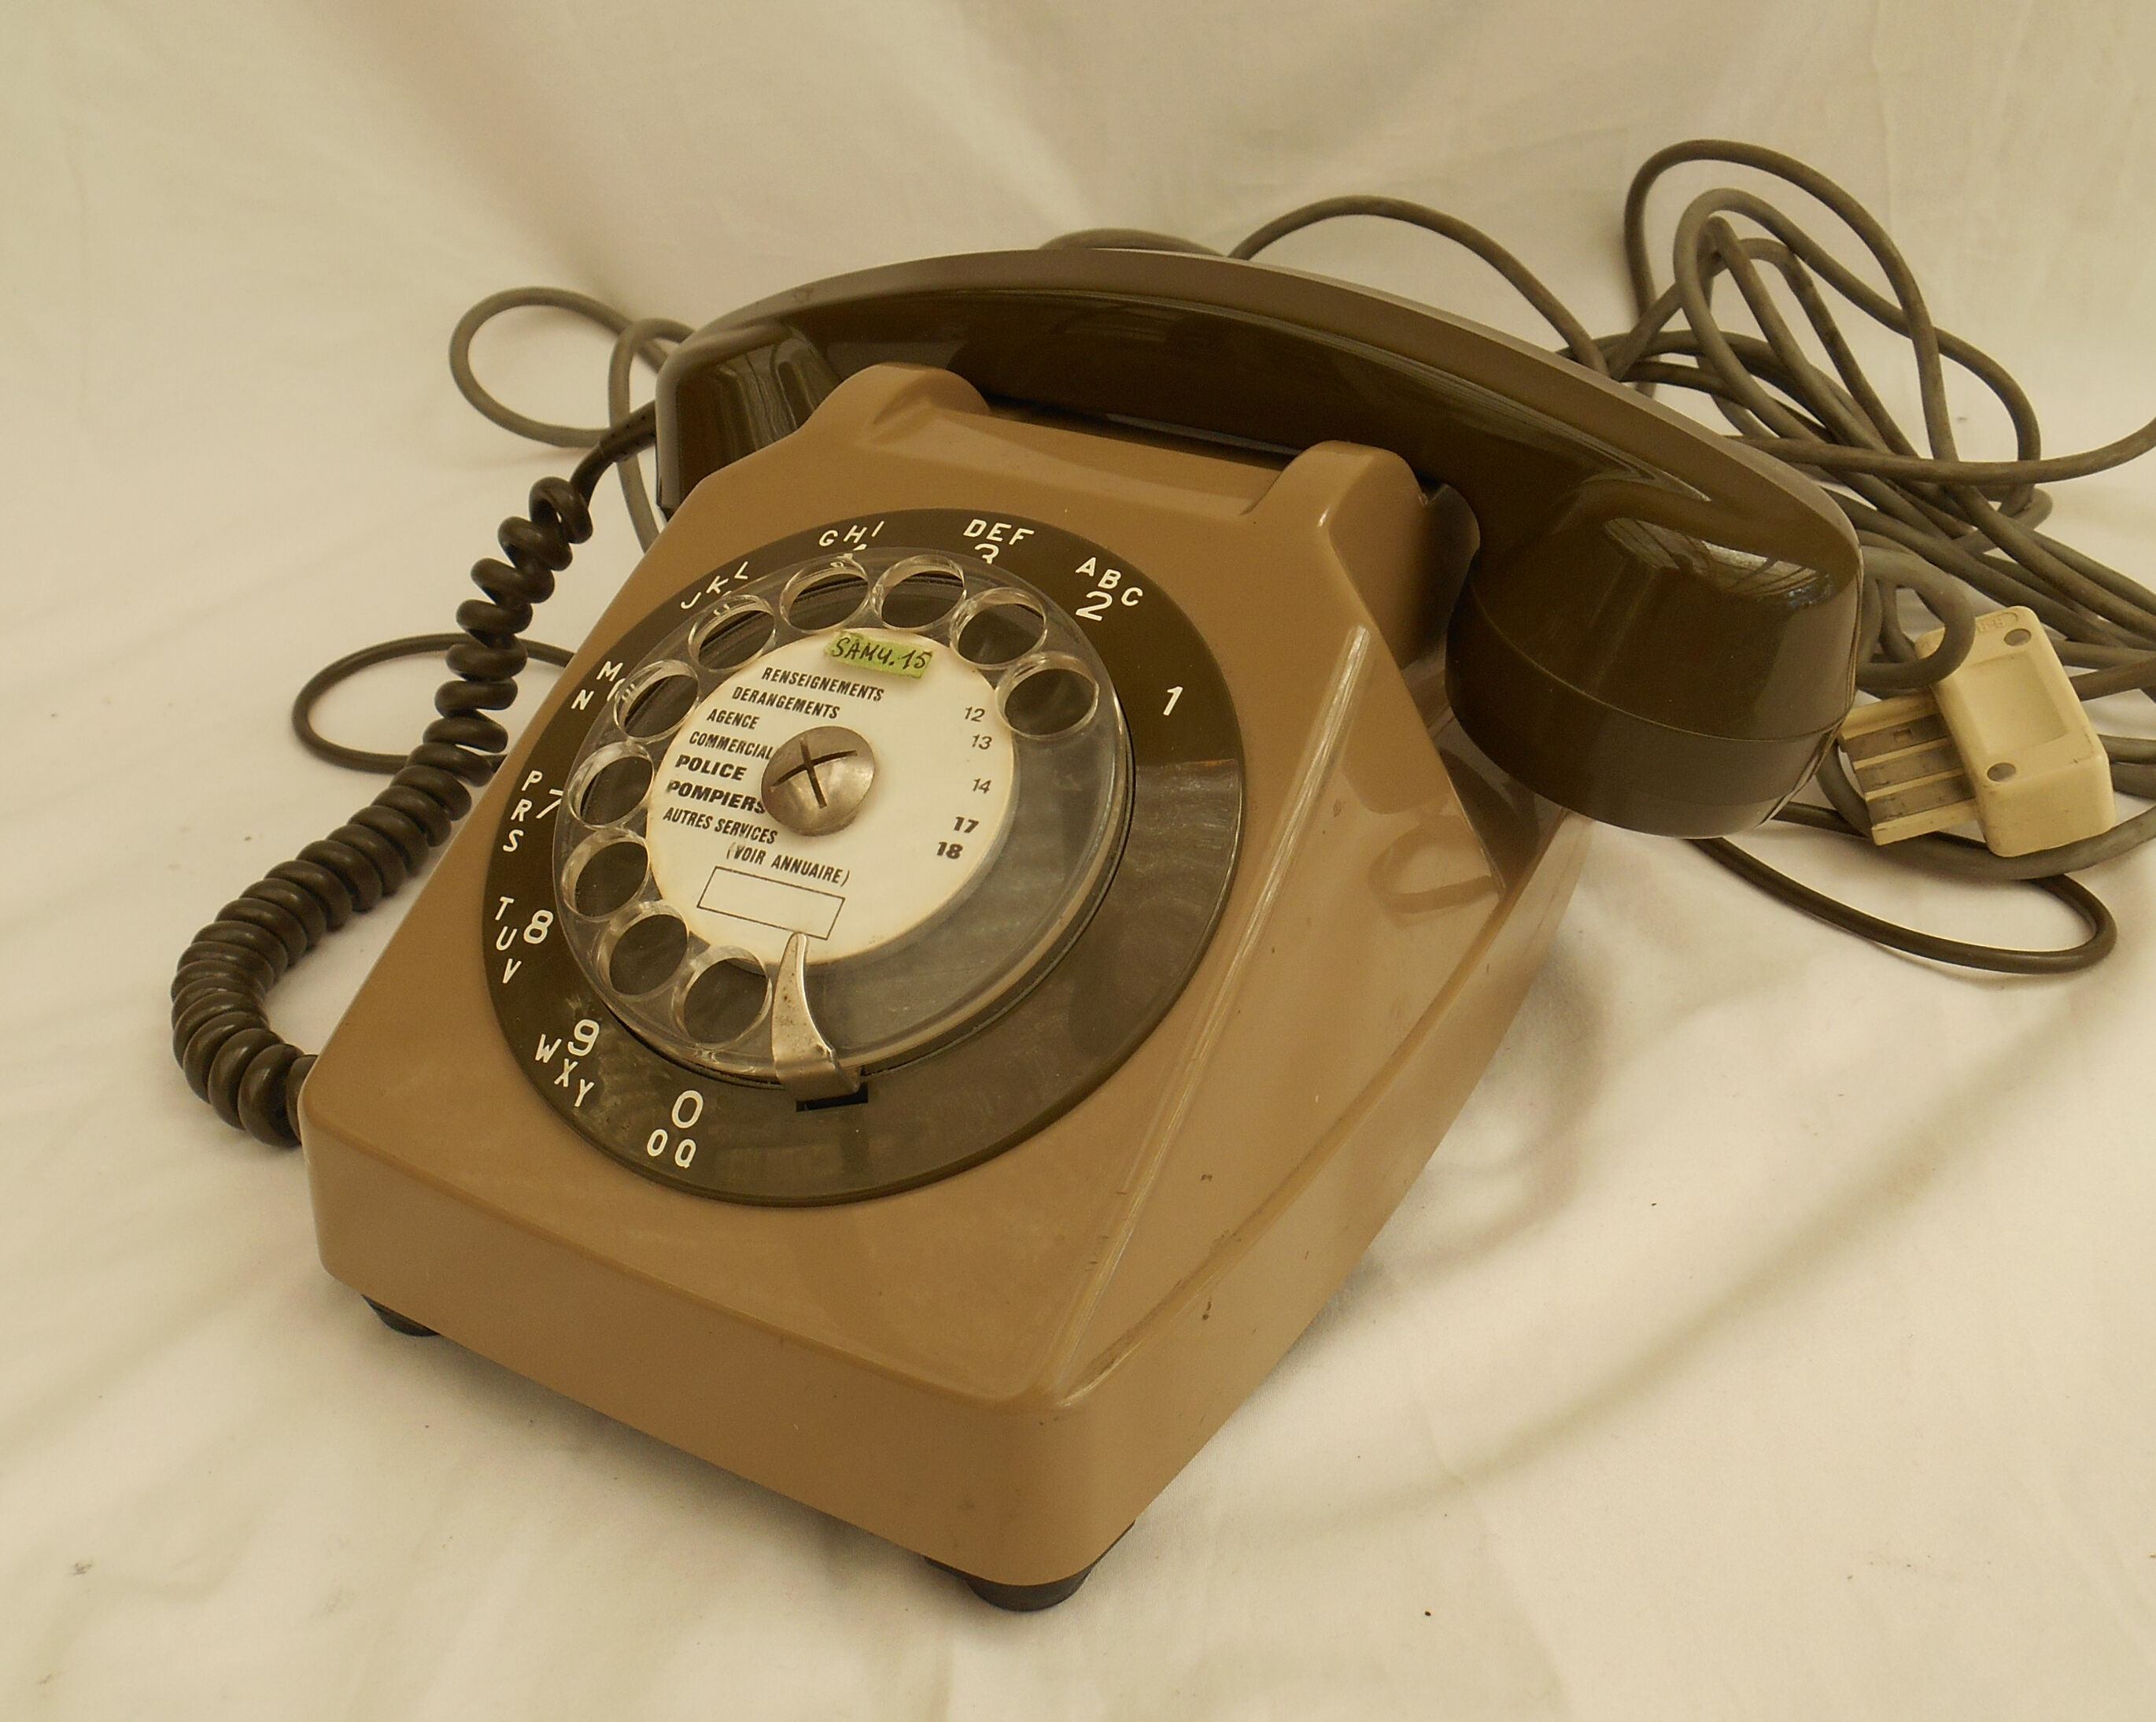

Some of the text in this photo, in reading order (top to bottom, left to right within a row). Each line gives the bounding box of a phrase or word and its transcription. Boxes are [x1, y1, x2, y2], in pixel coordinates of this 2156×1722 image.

[819, 520, 884, 547] GHI
[962, 519, 1035, 545] DEF
[681, 561, 748, 609] JKL
[1075, 556, 1143, 606] ABC
[1075, 590, 1113, 622] 2
[762, 667, 985, 722] RENSEIGNEMENTS 12
[1161, 685, 1183, 715] 1
[707, 708, 760, 730] AGENCE
[732, 686, 992, 750] DERANGEMENTS 13
[536, 789, 563, 819] 7
[675, 754, 980, 834] POLICE 17
[973, 778, 992, 794] 14
[663, 807, 778, 844] AUTRES SERVICES
[666, 779, 964, 859] POMPIERS 18
[523, 909, 554, 944] 8
[567, 1018, 600, 1056] 9
[535, 1033, 594, 1107] WXY
[671, 1090, 704, 1129] 0
